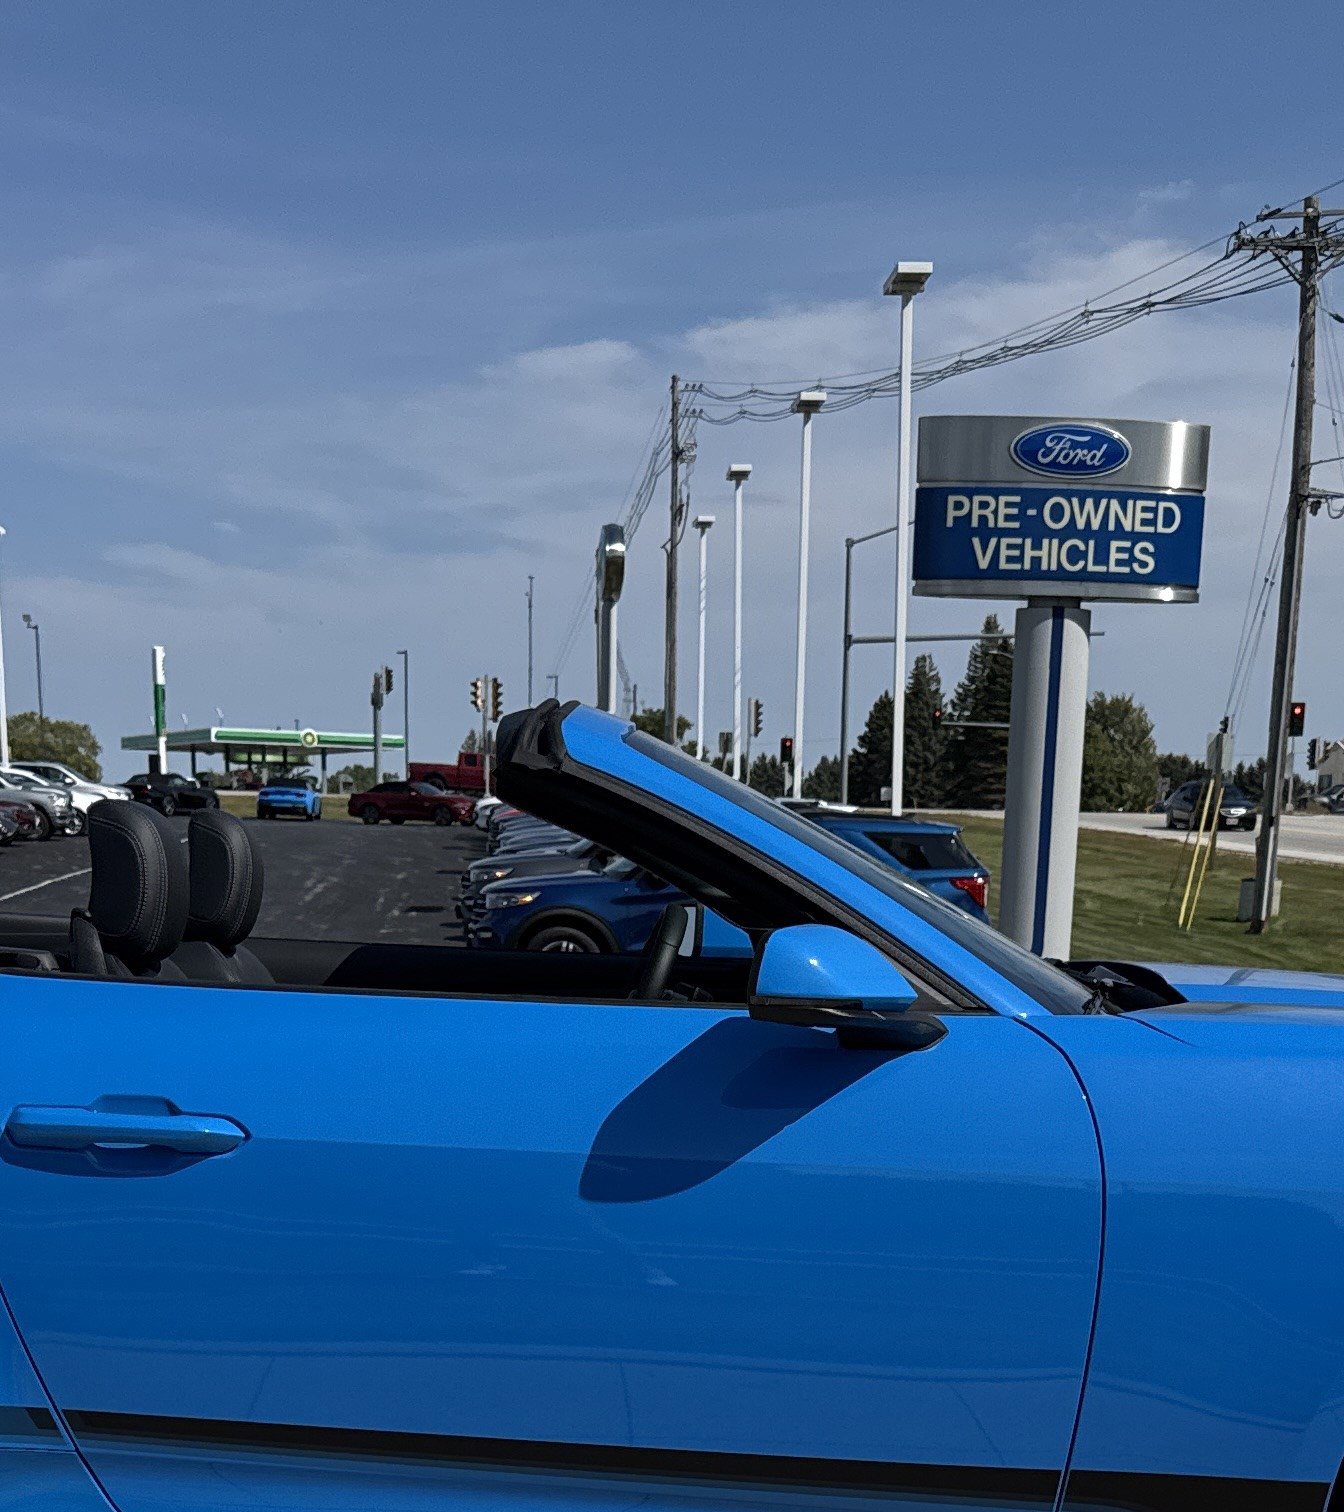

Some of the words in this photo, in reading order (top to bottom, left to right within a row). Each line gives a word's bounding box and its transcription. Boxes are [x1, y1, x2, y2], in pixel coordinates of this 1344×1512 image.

[1037, 433, 1107, 466] Ford
[945, 494, 1182, 535] PRE-OWNED
[971, 536, 1156, 575] VEHICLES
